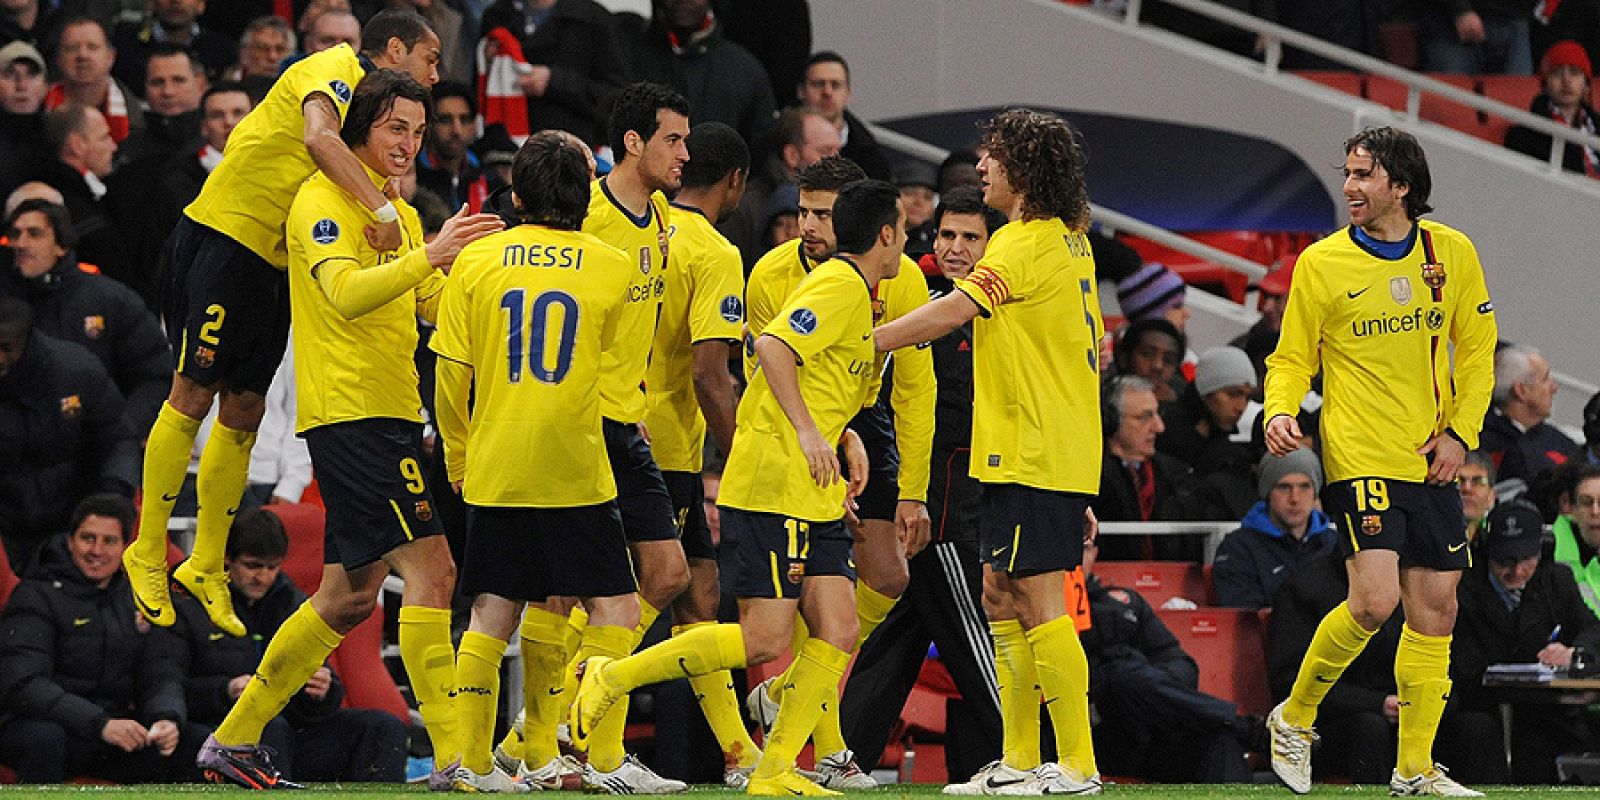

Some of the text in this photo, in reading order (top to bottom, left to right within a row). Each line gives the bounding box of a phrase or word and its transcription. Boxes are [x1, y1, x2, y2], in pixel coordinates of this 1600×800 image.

[502, 244, 584, 270] MESSI
[199, 304, 226, 345] 2
[499, 289, 580, 384] 10
[1351, 308, 1421, 337] unicef
[399, 457, 425, 495] 9
[1348, 479, 1391, 512] 19
[783, 518, 810, 559] 17
[1074, 582, 1086, 616] 2
